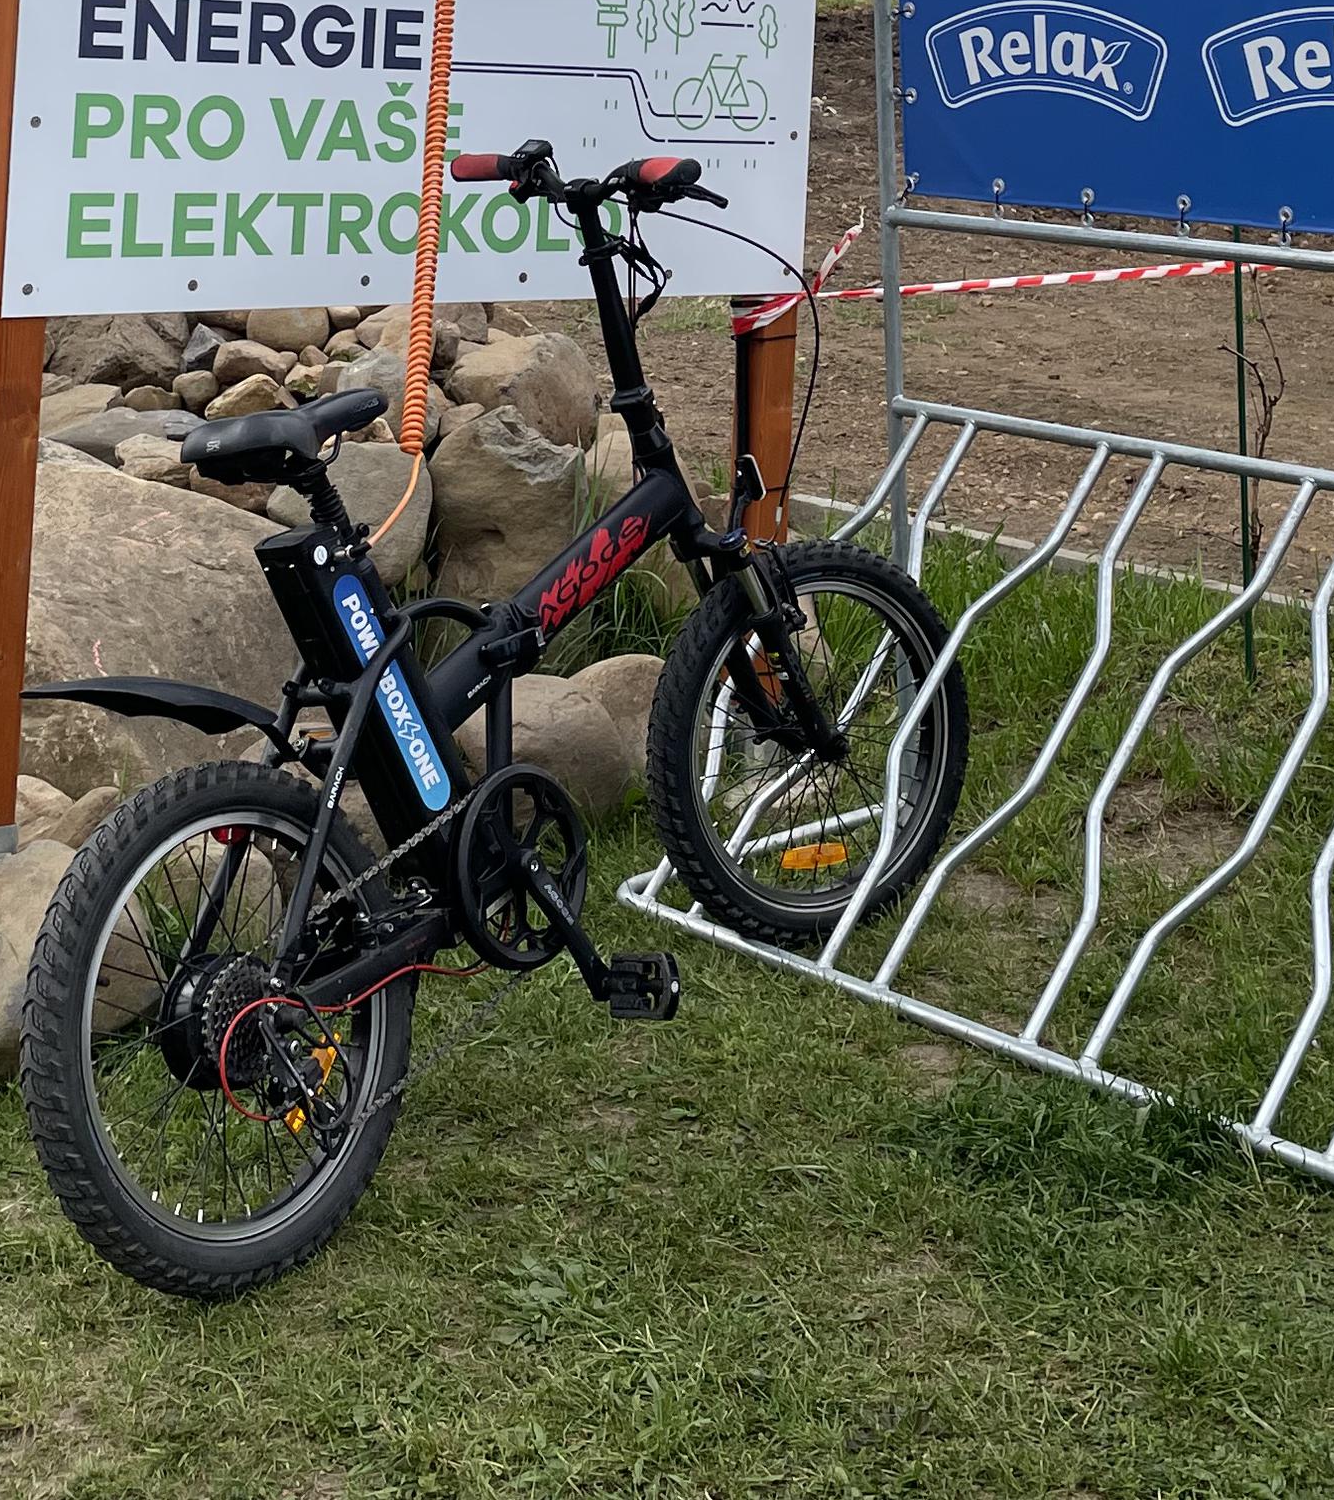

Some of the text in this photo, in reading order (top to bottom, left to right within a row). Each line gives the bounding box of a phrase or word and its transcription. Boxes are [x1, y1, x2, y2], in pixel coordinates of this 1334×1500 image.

[958, 14, 1130, 92] Relax
[72, 92, 245, 161] PRO
[342, 592, 442, 791] POWBOX ONE
